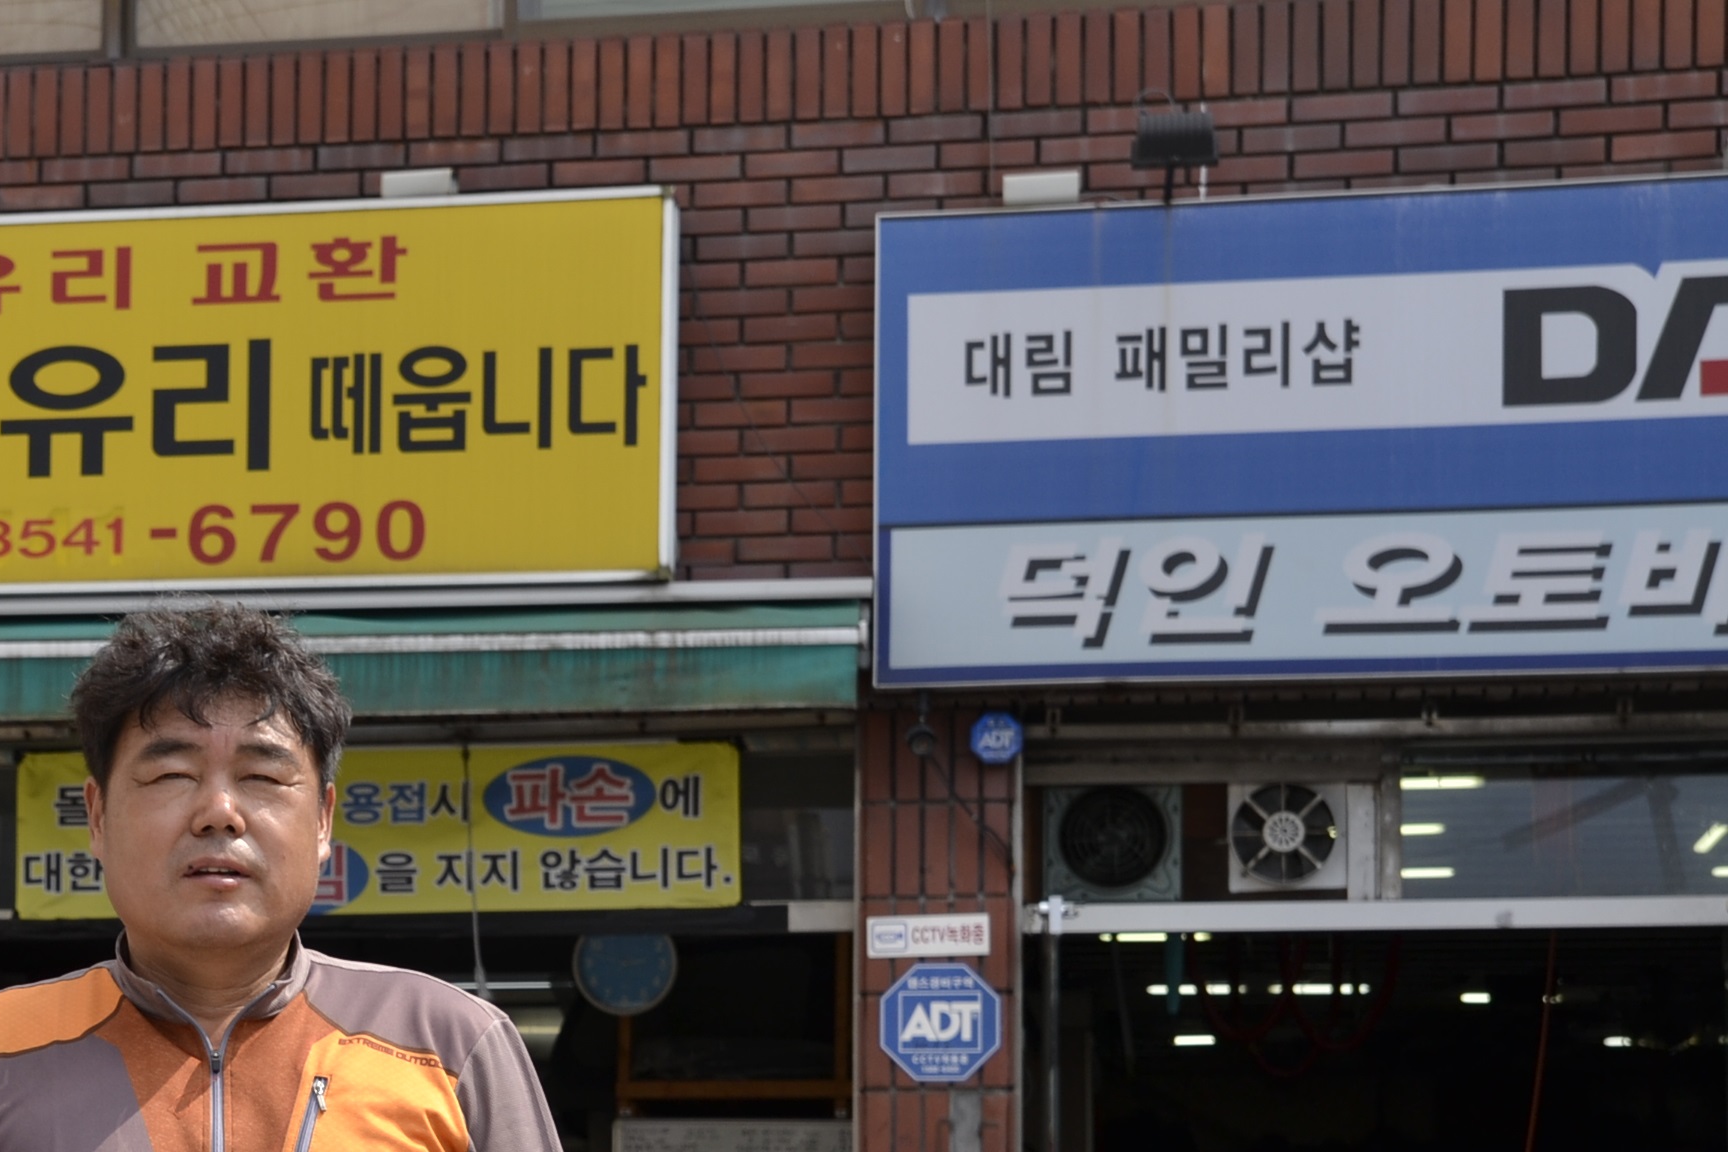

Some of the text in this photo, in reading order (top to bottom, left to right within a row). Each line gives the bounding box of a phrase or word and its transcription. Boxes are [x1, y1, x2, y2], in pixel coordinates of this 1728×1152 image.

[192, 235, 408, 306] 교환
[964, 318, 1360, 398] 대림 패밀리샵
[310, 344, 648, 455] 떼웁니다
[997, 533, 1276, 650] 덕인
[342, 781, 469, 825] 용접시
[25, 853, 103, 892] 대한
[436, 850, 519, 892] 지지
[540, 847, 732, 890] 않습니다.
[338, 1037, 394, 1056] EXTREME
[900, 1001, 981, 1042] ADT
